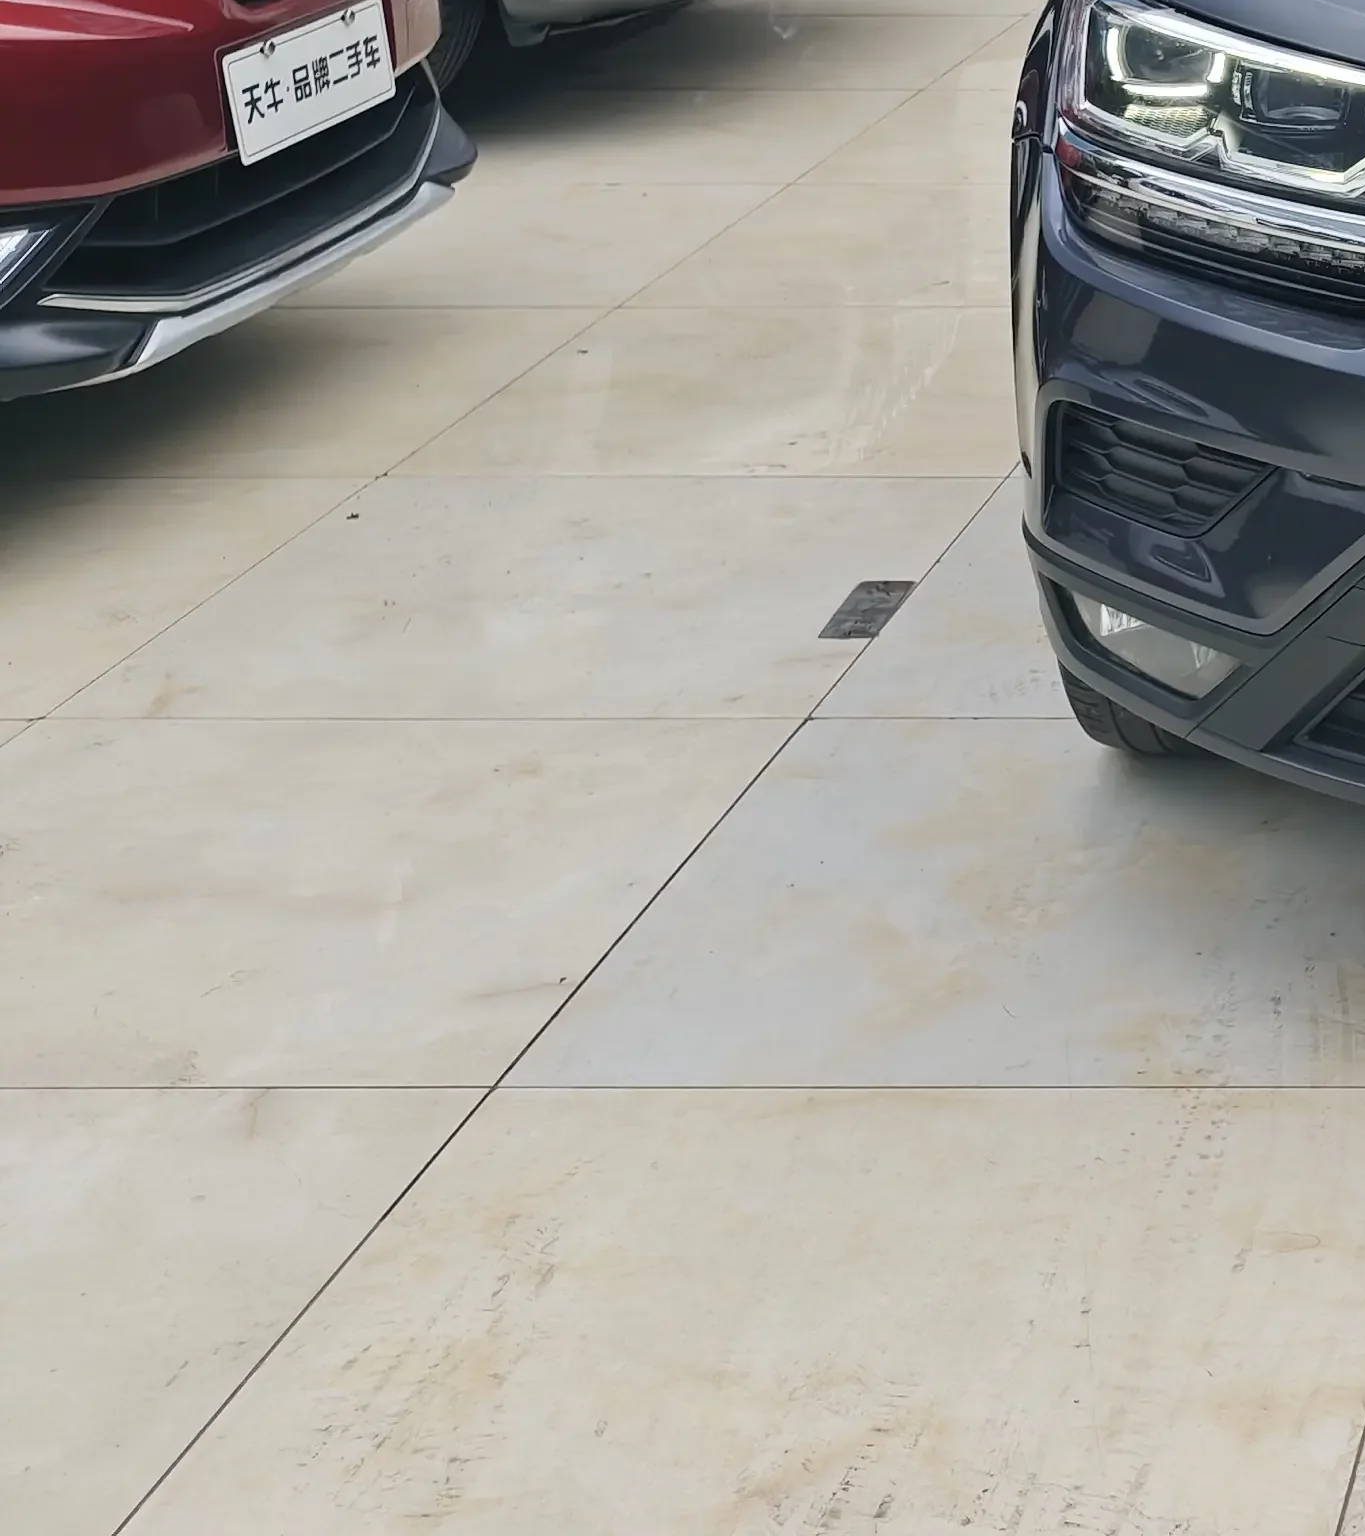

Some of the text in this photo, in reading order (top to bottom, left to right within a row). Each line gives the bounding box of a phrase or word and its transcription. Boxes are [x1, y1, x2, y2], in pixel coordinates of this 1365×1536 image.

[241, 35, 382, 126] 天牛·品牌二手车
